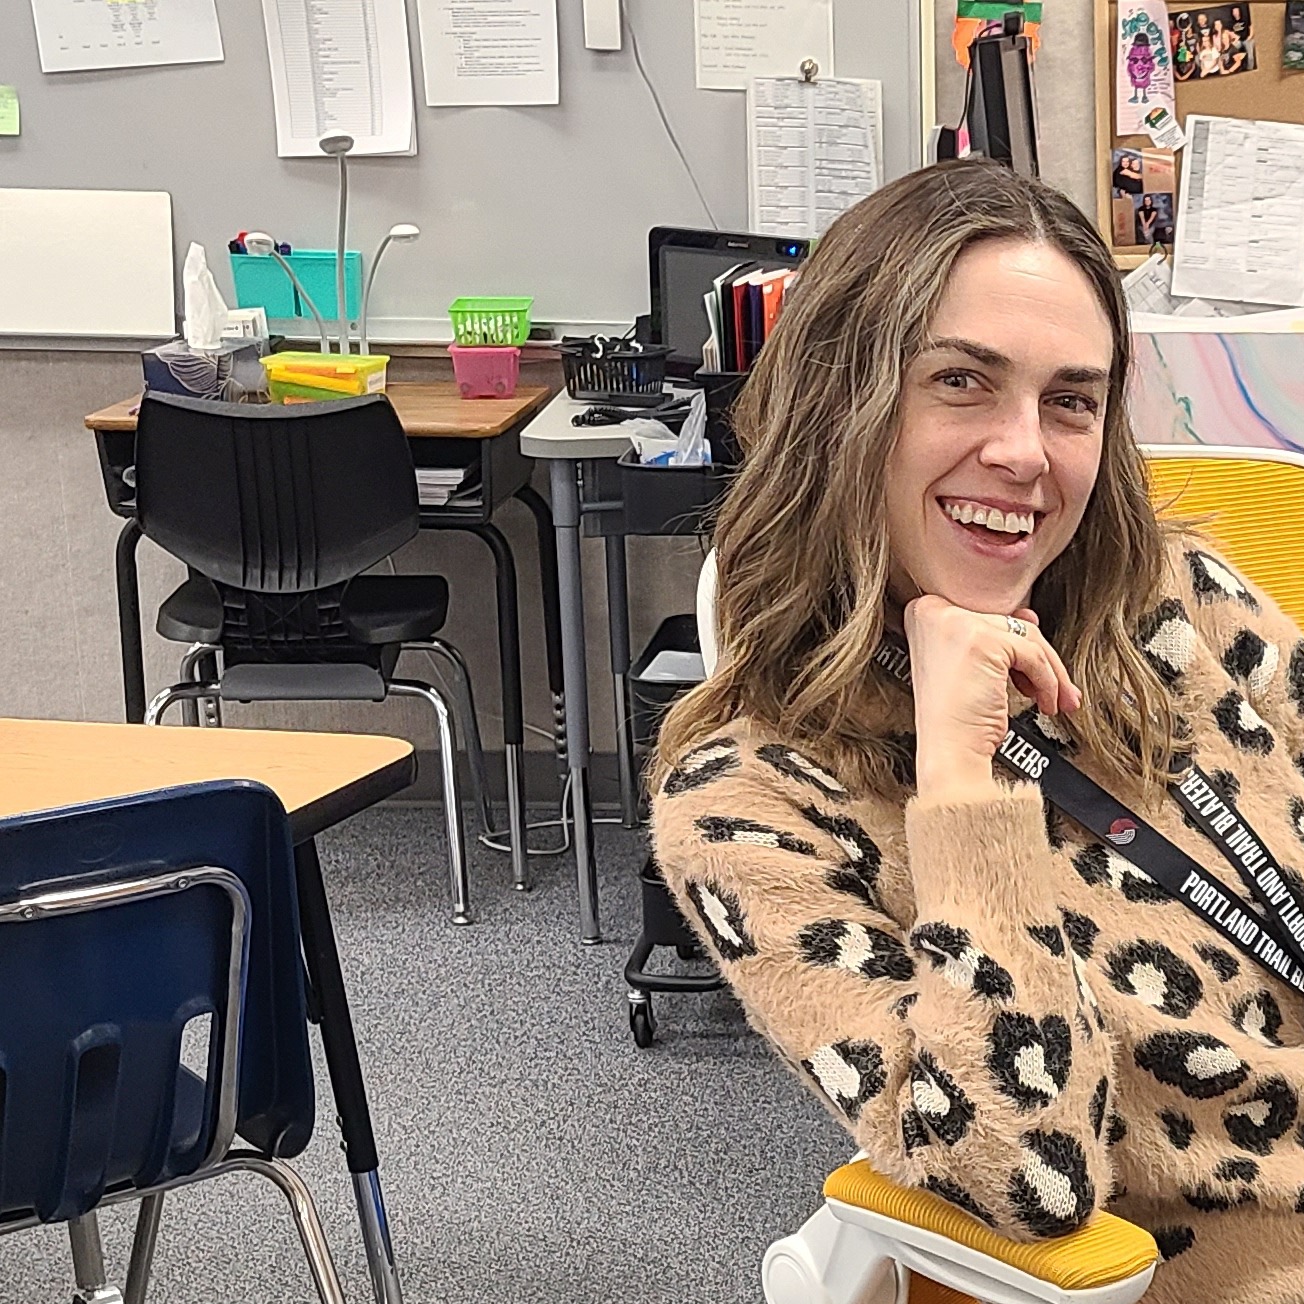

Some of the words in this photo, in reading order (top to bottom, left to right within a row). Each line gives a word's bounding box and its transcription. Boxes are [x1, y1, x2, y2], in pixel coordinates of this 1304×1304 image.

[1000, 730, 1050, 779] AZERS
[1180, 769, 1238, 837] BLAZER
[1225, 823, 1268, 878] TRAIL
[1180, 870, 1260, 946] PORTLAND
[1253, 930, 1293, 979] TRAIL
